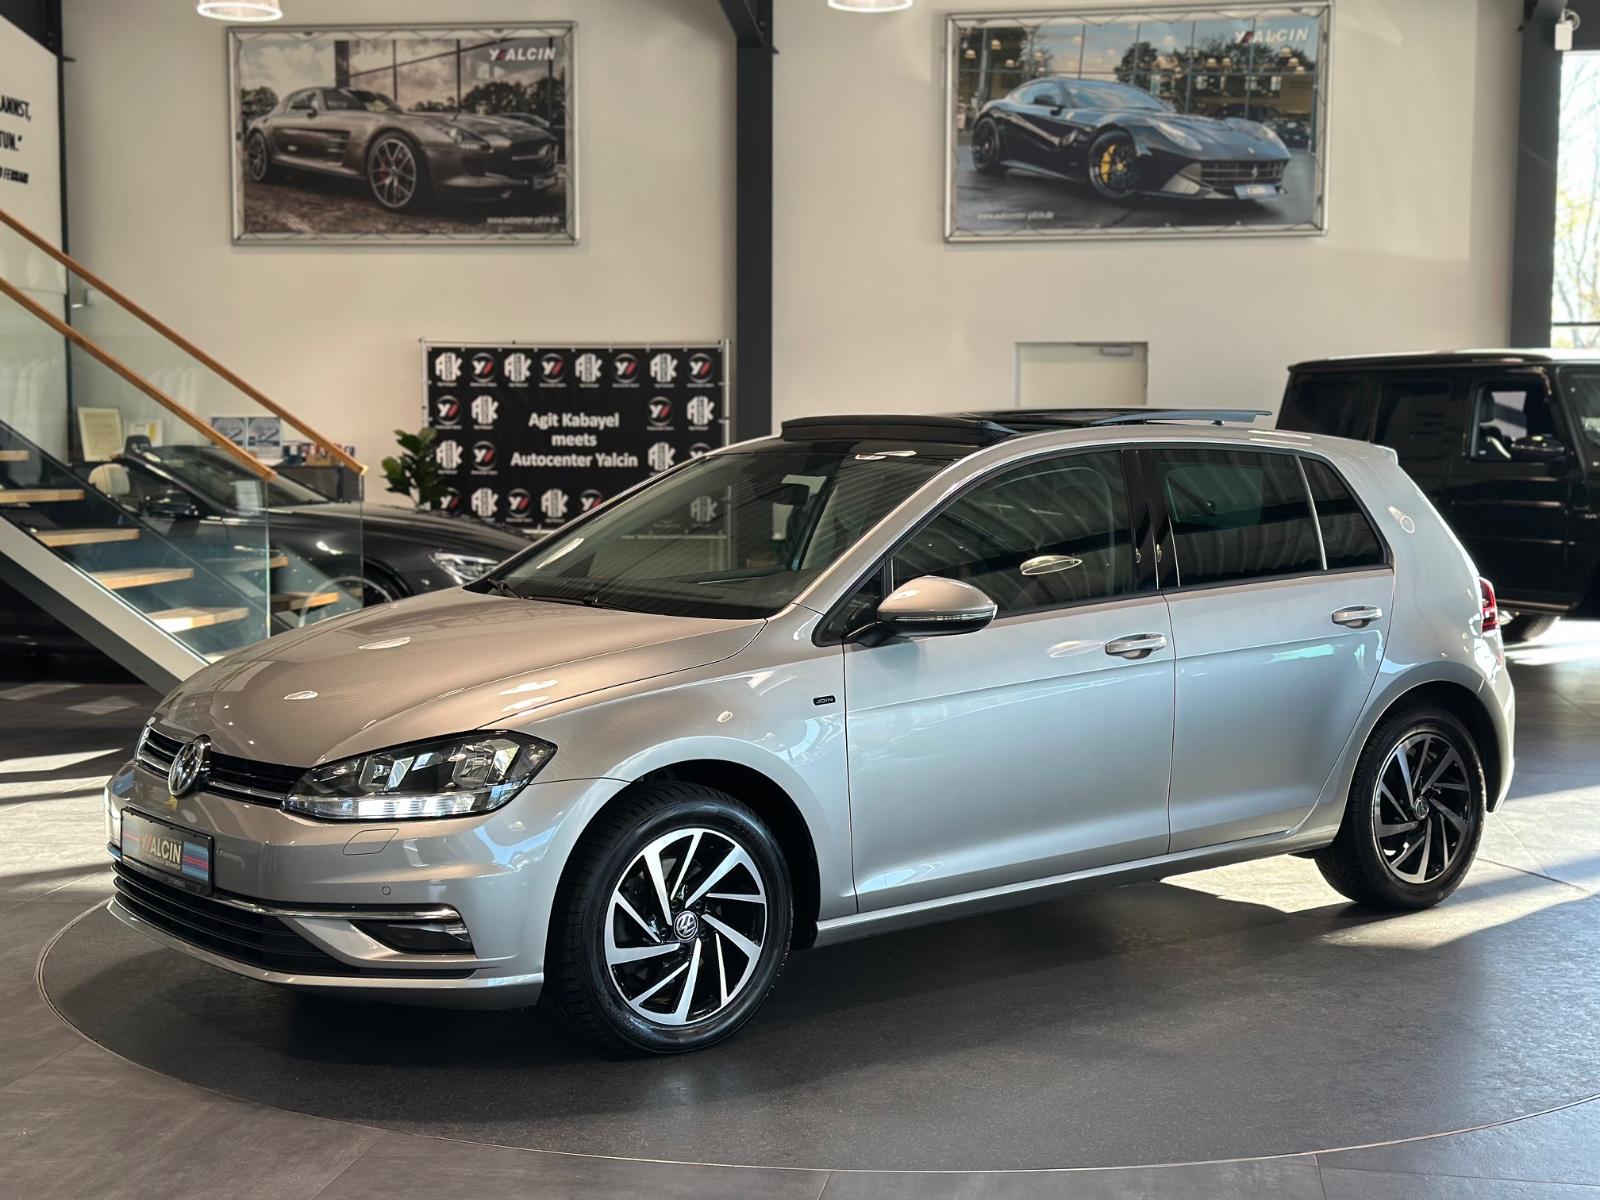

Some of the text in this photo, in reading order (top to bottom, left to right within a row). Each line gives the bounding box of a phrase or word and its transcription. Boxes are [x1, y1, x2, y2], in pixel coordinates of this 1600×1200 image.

[1234, 27, 1309, 43] YALCIN
[489, 47, 556, 61] YALCIN
[528, 412, 620, 430] Agit Kabayel
[551, 434, 598, 446] meets
[510, 452, 638, 467] Autocenter Yalcin
